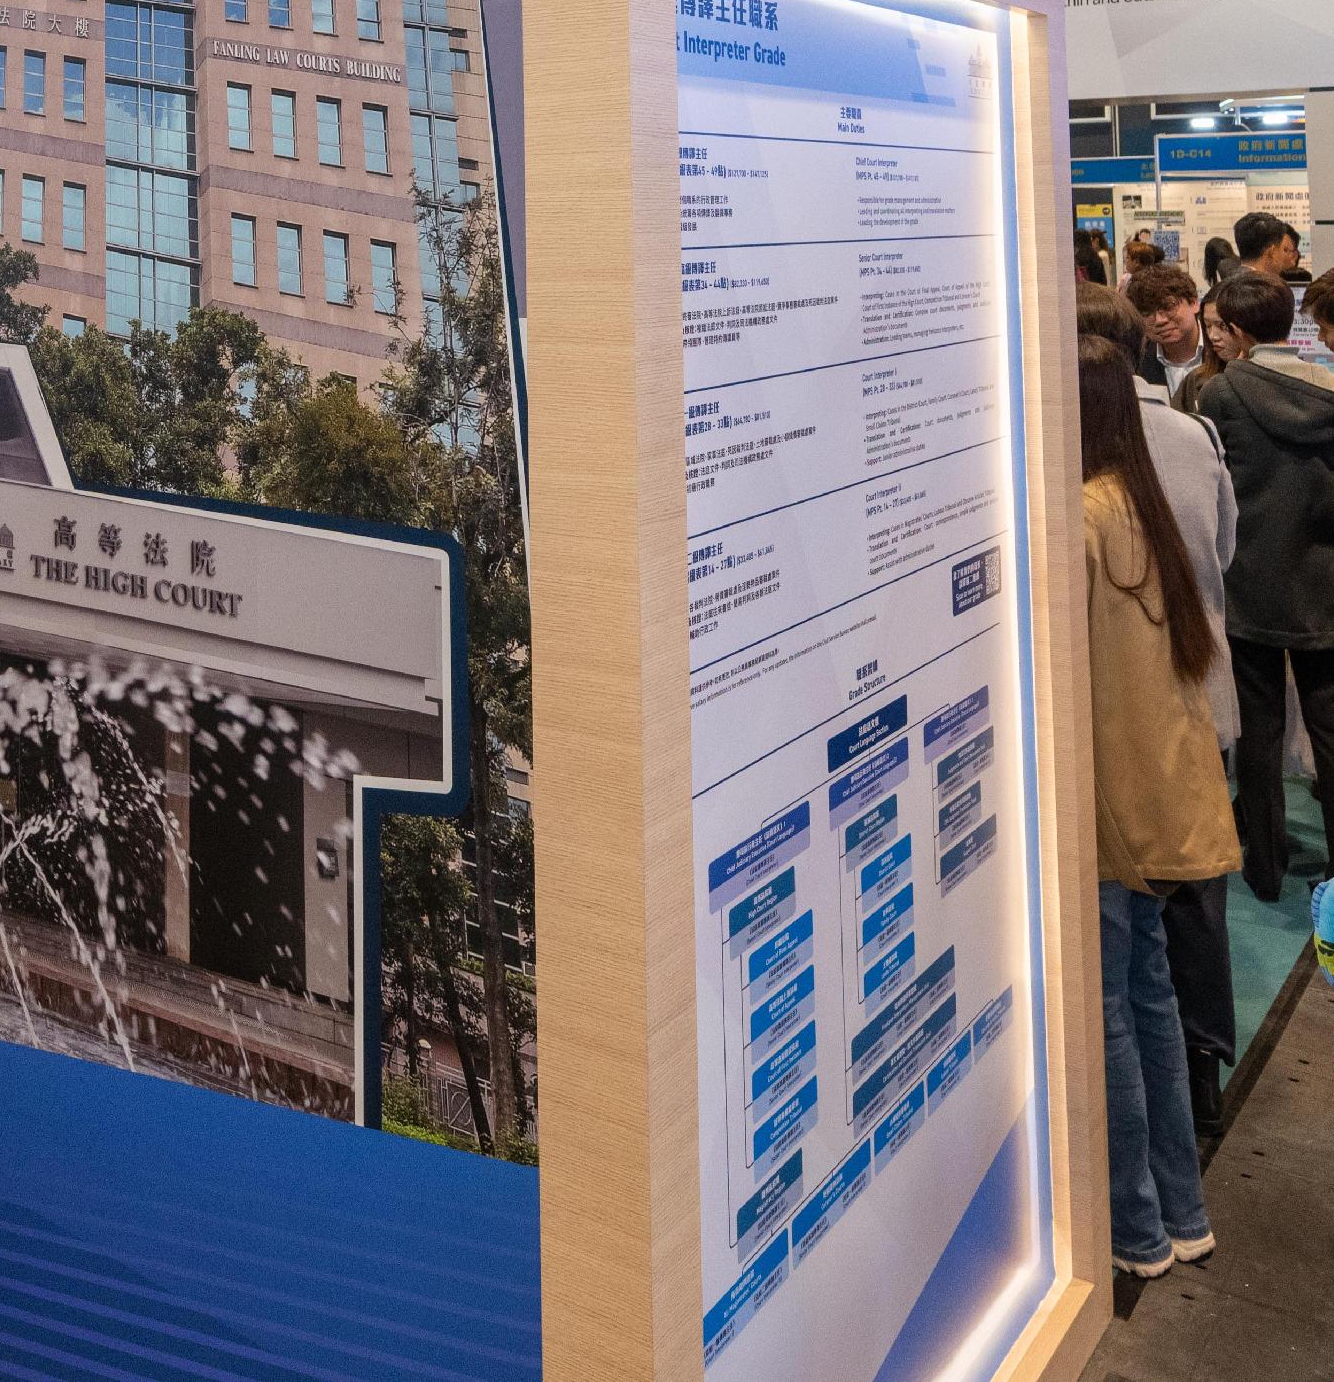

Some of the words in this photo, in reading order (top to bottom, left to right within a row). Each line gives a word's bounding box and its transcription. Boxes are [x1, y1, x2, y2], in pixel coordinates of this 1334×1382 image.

[212, 40, 261, 62] FANLING
[265, 46, 291, 65] LAW
[295, 50, 341, 74] COURTS
[346, 59, 402, 83] BUILDING
[683, 30, 751, 63] Interpreter
[753, 42, 786, 67] Grade
[53, 514, 217, 577] 高等法院
[30, 554, 79, 586] THE
[84, 564, 148, 600] HIGH
[153, 578, 244, 617] COURT
